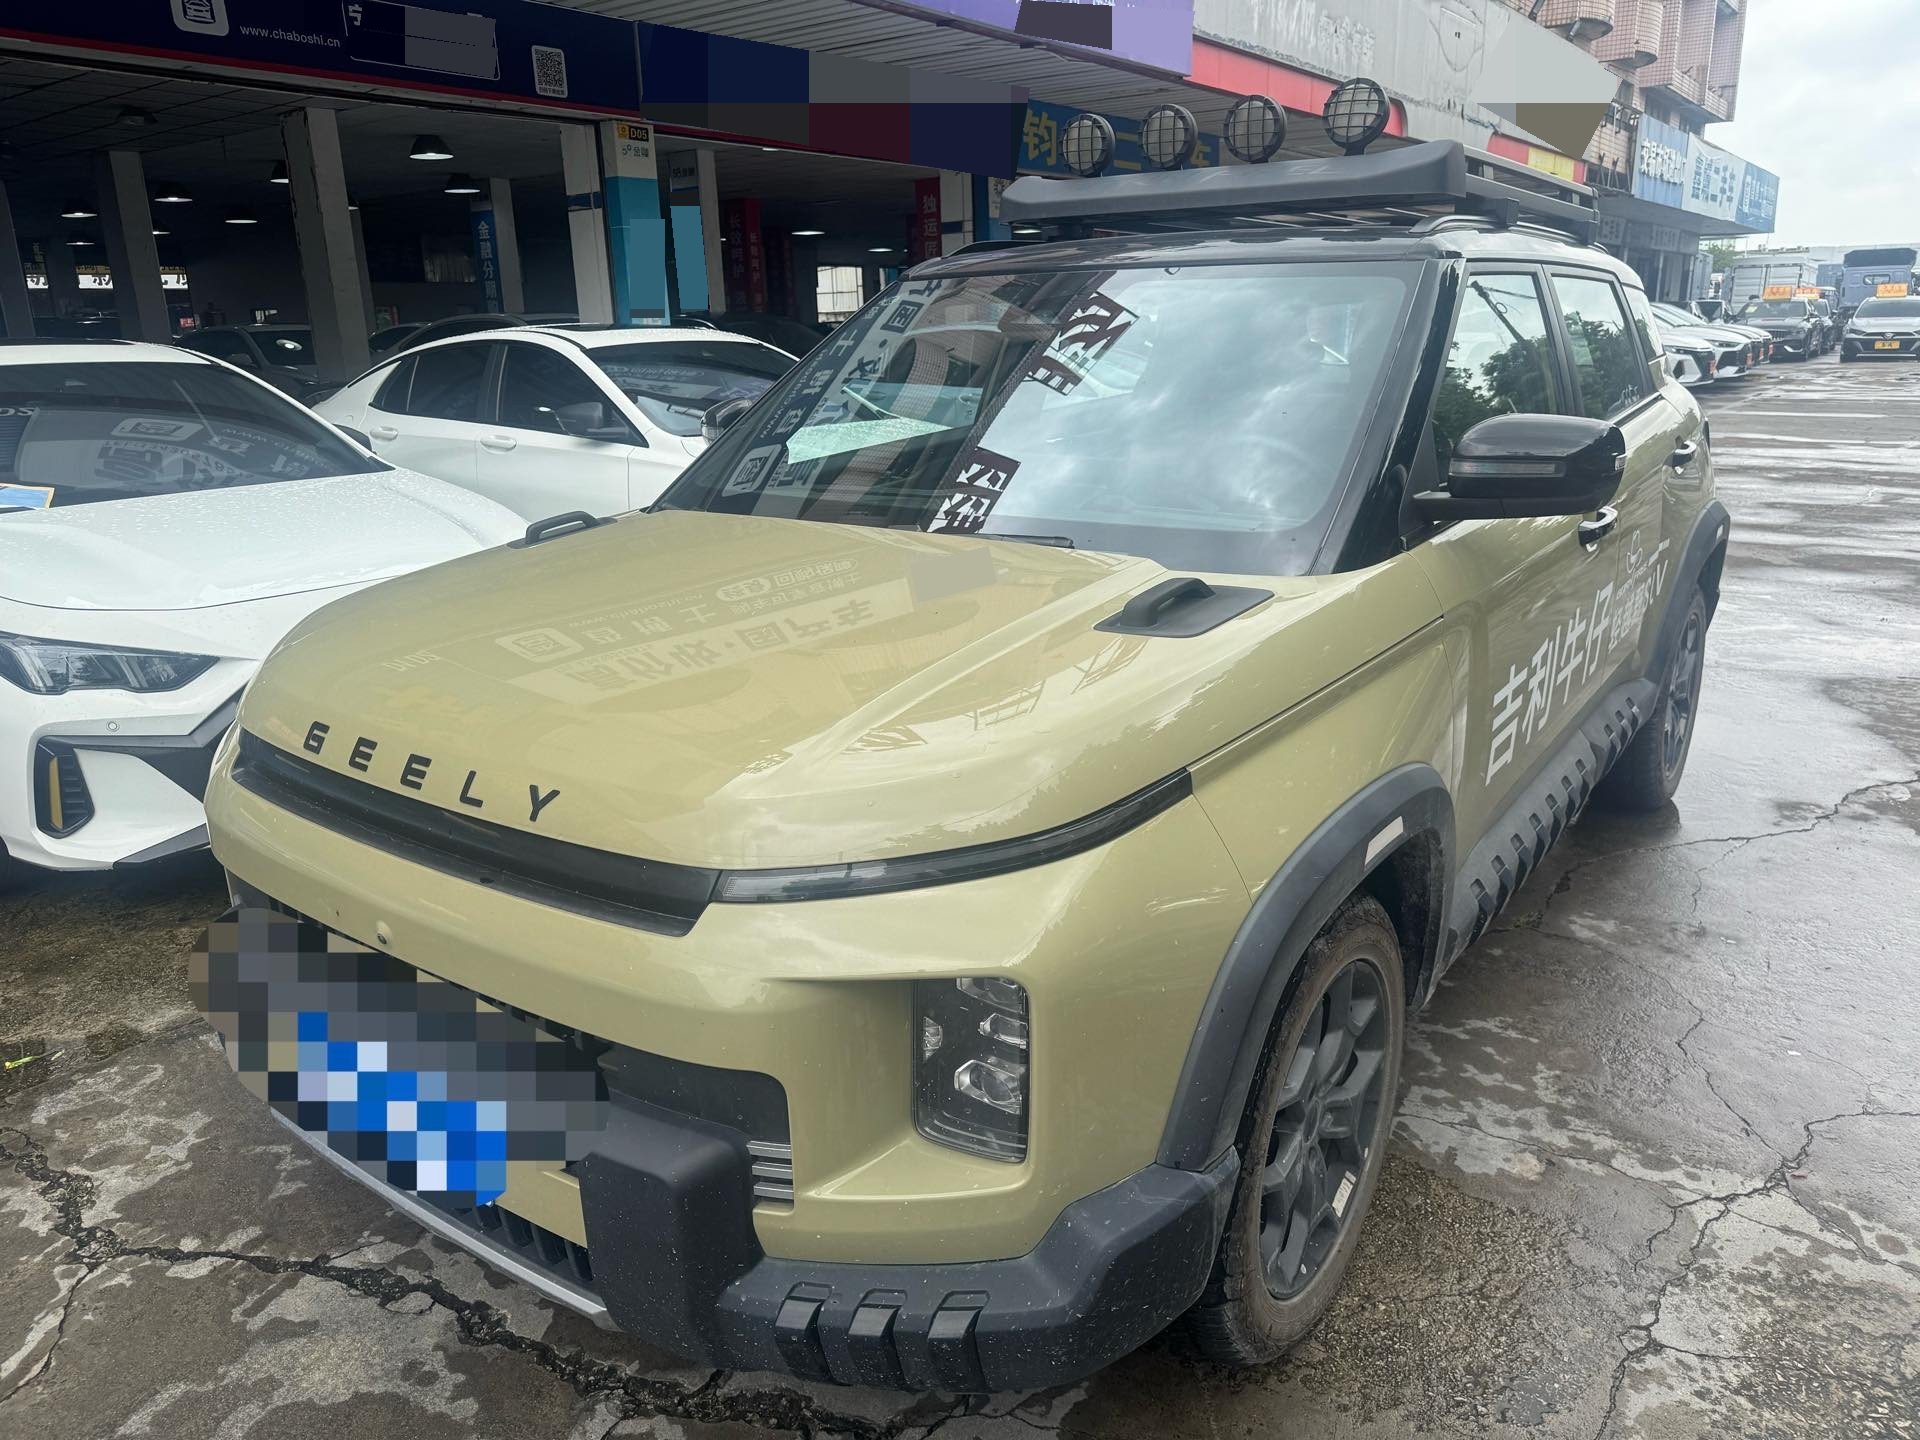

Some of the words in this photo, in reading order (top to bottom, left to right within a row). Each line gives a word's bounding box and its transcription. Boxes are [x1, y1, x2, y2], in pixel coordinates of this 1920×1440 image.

[239, 25, 341, 48] www.chaboshi.cn
[630, 127, 648, 140] D05
[1485, 582, 1614, 786] 吉利牛仔
[302, 720, 561, 823] GEELY
